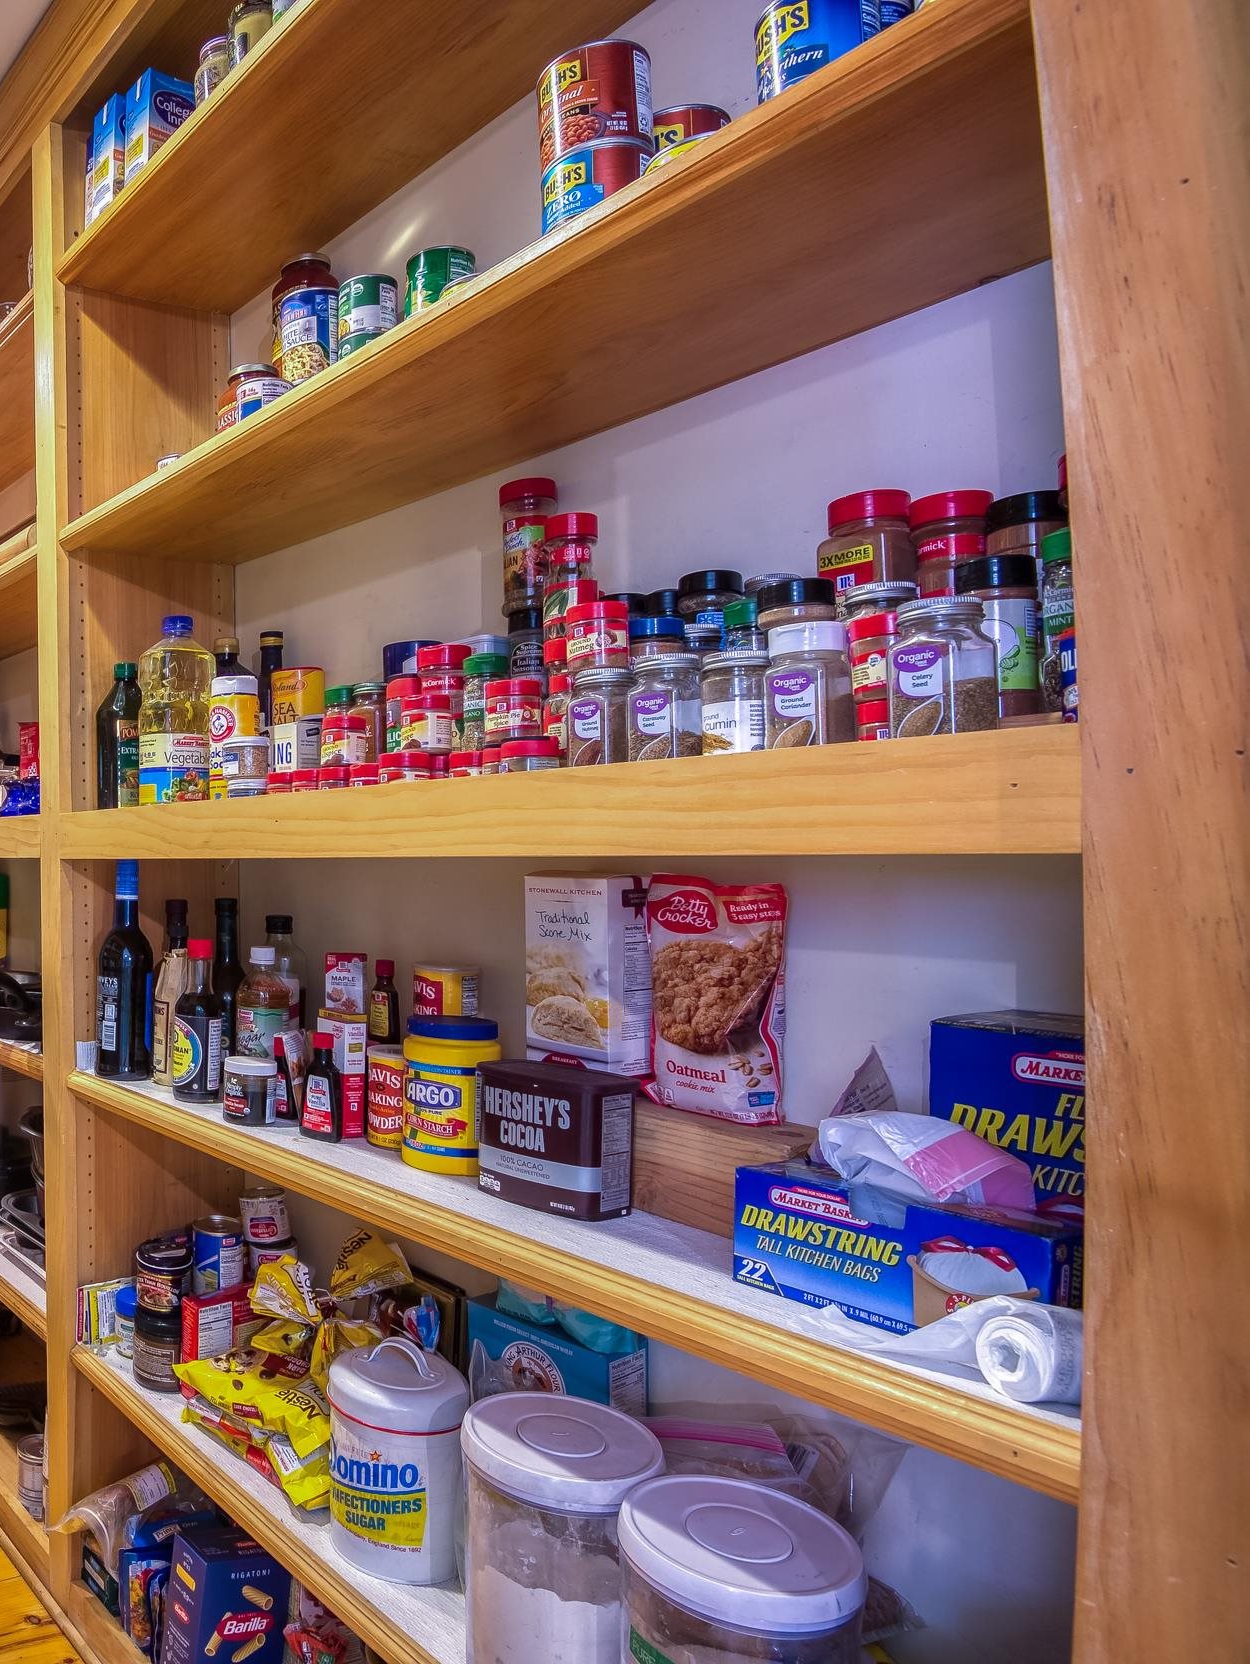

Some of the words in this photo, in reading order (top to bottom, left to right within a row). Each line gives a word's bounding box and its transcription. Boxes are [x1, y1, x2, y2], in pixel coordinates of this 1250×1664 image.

[757, 5, 805, 55] USH'S
[541, 63, 578, 104] BUH'S
[541, 85, 583, 124] Oriinal
[561, 108, 580, 119] EANS
[544, 165, 584, 202] BUH'S
[917, 540, 947, 554] rmick
[819, 554, 834, 570] 3X
[834, 546, 871, 562] MORE
[1050, 616, 1072, 626] MINT
[897, 649, 935, 665] Organic
[773, 676, 807, 689] Organic
[911, 673, 934, 683] Celery
[911, 681, 928, 689] Seed
[636, 696, 664, 709] Organic
[780, 696, 804, 704] Ground
[780, 701, 812, 711] Coriander
[274, 702, 296, 716] SEA
[573, 703, 596, 715] Organic
[703, 712, 720, 722] round
[704, 718, 737, 732] cumin
[121, 746, 139, 755] EXTR
[273, 741, 293, 765] ING
[164, 751, 211, 768] Vegetab
[528, 887, 568, 896] STONEWALL
[669, 895, 710, 919] Betty
[729, 903, 758, 913] Ready
[758, 902, 770, 910] in
[534, 907, 591, 925] Traditional
[657, 907, 717, 929] Crocker
[731, 912, 738, 921] 3
[738, 912, 759, 921] easy
[538, 924, 566, 939] Scone
[567, 926, 593, 942] Mix
[414, 1005, 438, 1016] KING
[665, 1060, 727, 1084] Oatmeal
[1020, 1060, 1085, 1082] MARKE
[407, 1081, 455, 1107] ARGO
[675, 1079, 699, 1091] cookie
[699, 1085, 716, 1094] mix
[369, 1094, 403, 1109] AKING
[485, 1085, 571, 1130] HERSHEY'S
[1054, 1093, 1085, 1121] FL
[369, 1114, 403, 1130] OWDER
[405, 1113, 423, 1129] CORN
[423, 1119, 454, 1135] STARCH
[500, 1119, 546, 1153] COCOA
[496, 1162, 515, 1172] NATURAL
[514, 1167, 550, 1180] UNSWEETENED
[500, 1154, 516, 1165] 100%
[516, 1158, 545, 1172] CACAO
[774, 1191, 821, 1212] MARKET
[821, 1202, 867, 1223] BASK
[740, 1204, 904, 1268] DRAWSTRING
[756, 1234, 783, 1256] TALL
[785, 1243, 843, 1273] KITCHEN
[843, 1259, 882, 1284] BAGS
[737, 1258, 767, 1282] 22
[736, 1274, 746, 1283] TALL
[746, 1276, 764, 1289] KITCHEN
[763, 1282, 775, 1291] BAGS
[869, 1312, 883, 1325] (60.9
[896, 1322, 909, 1333] 69.5
[516, 1345, 546, 1364] ARTHUR
[545, 1364, 562, 1393] FLOUR
[345, 1512, 386, 1532] SUGAR
[155, 1525, 176, 1540] Princ
[367, 1537, 390, 1550] England
[231, 1568, 271, 1579] RIGATONI
[223, 1617, 267, 1635] Barilla
